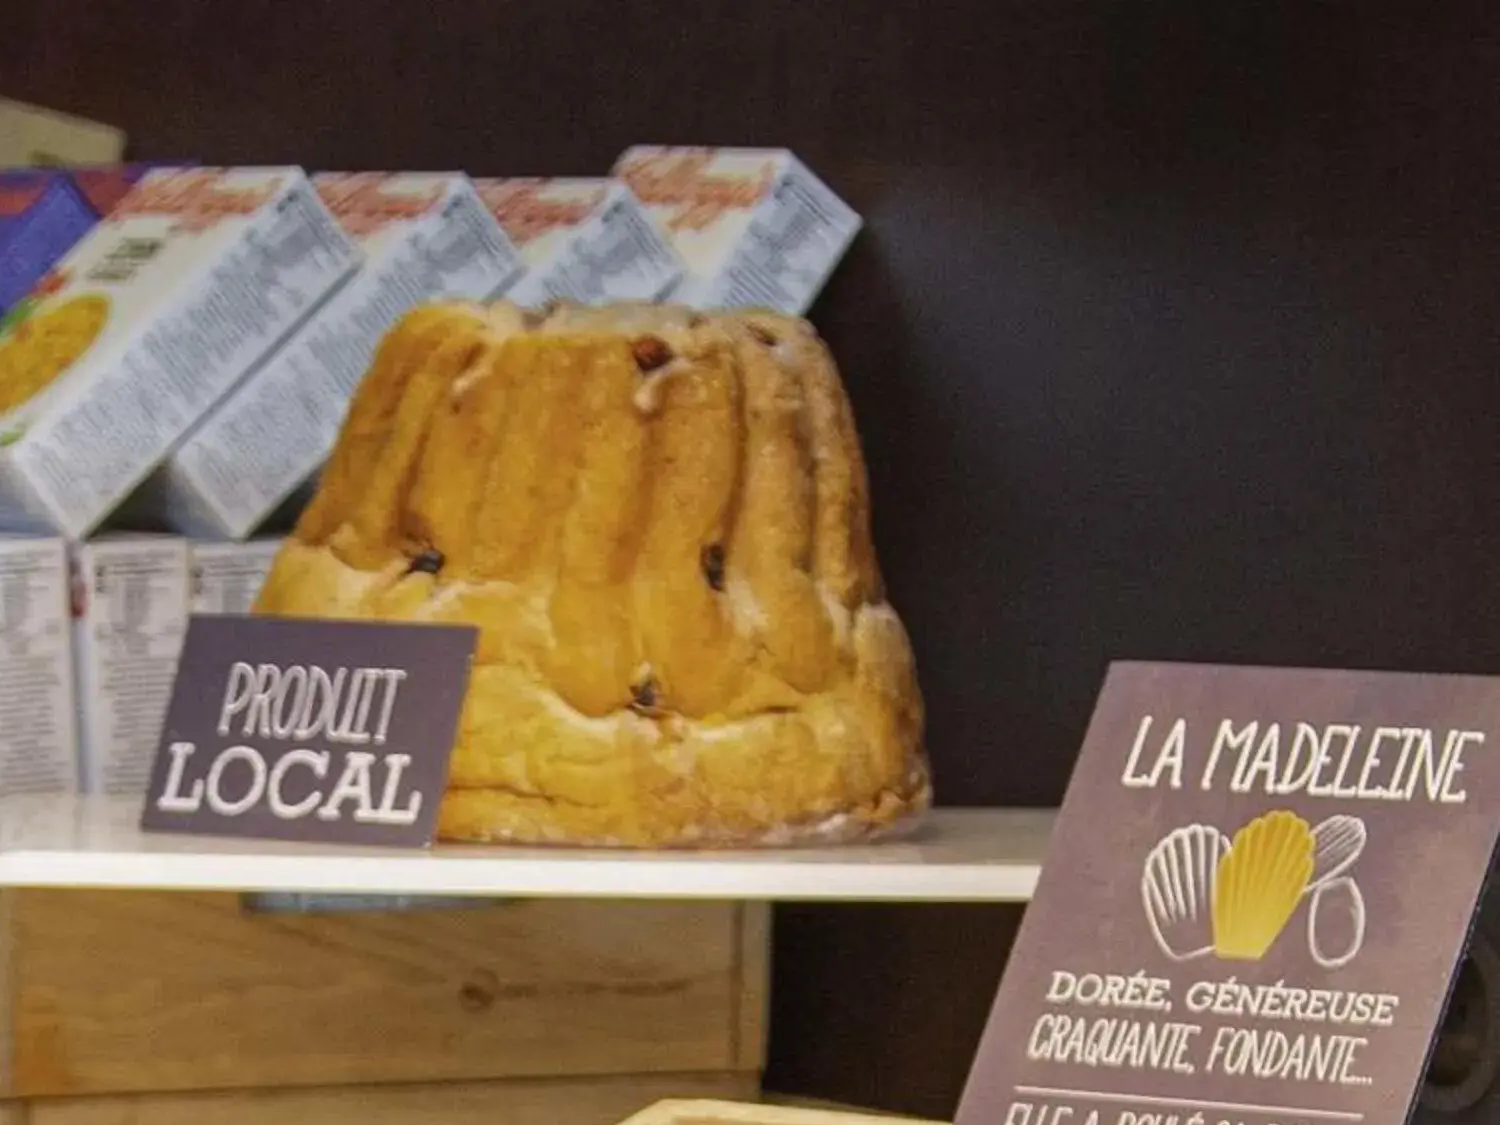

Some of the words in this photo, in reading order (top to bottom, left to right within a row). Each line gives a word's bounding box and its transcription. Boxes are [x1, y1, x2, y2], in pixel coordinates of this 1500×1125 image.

[217, 661, 407, 745] PRODUIT
[157, 741, 423, 825] LOCAL
[1121, 715, 1189, 790] LA
[1201, 719, 1485, 803] MADELEINE
[1185, 977, 1399, 1026] GÉNÉREUSE
